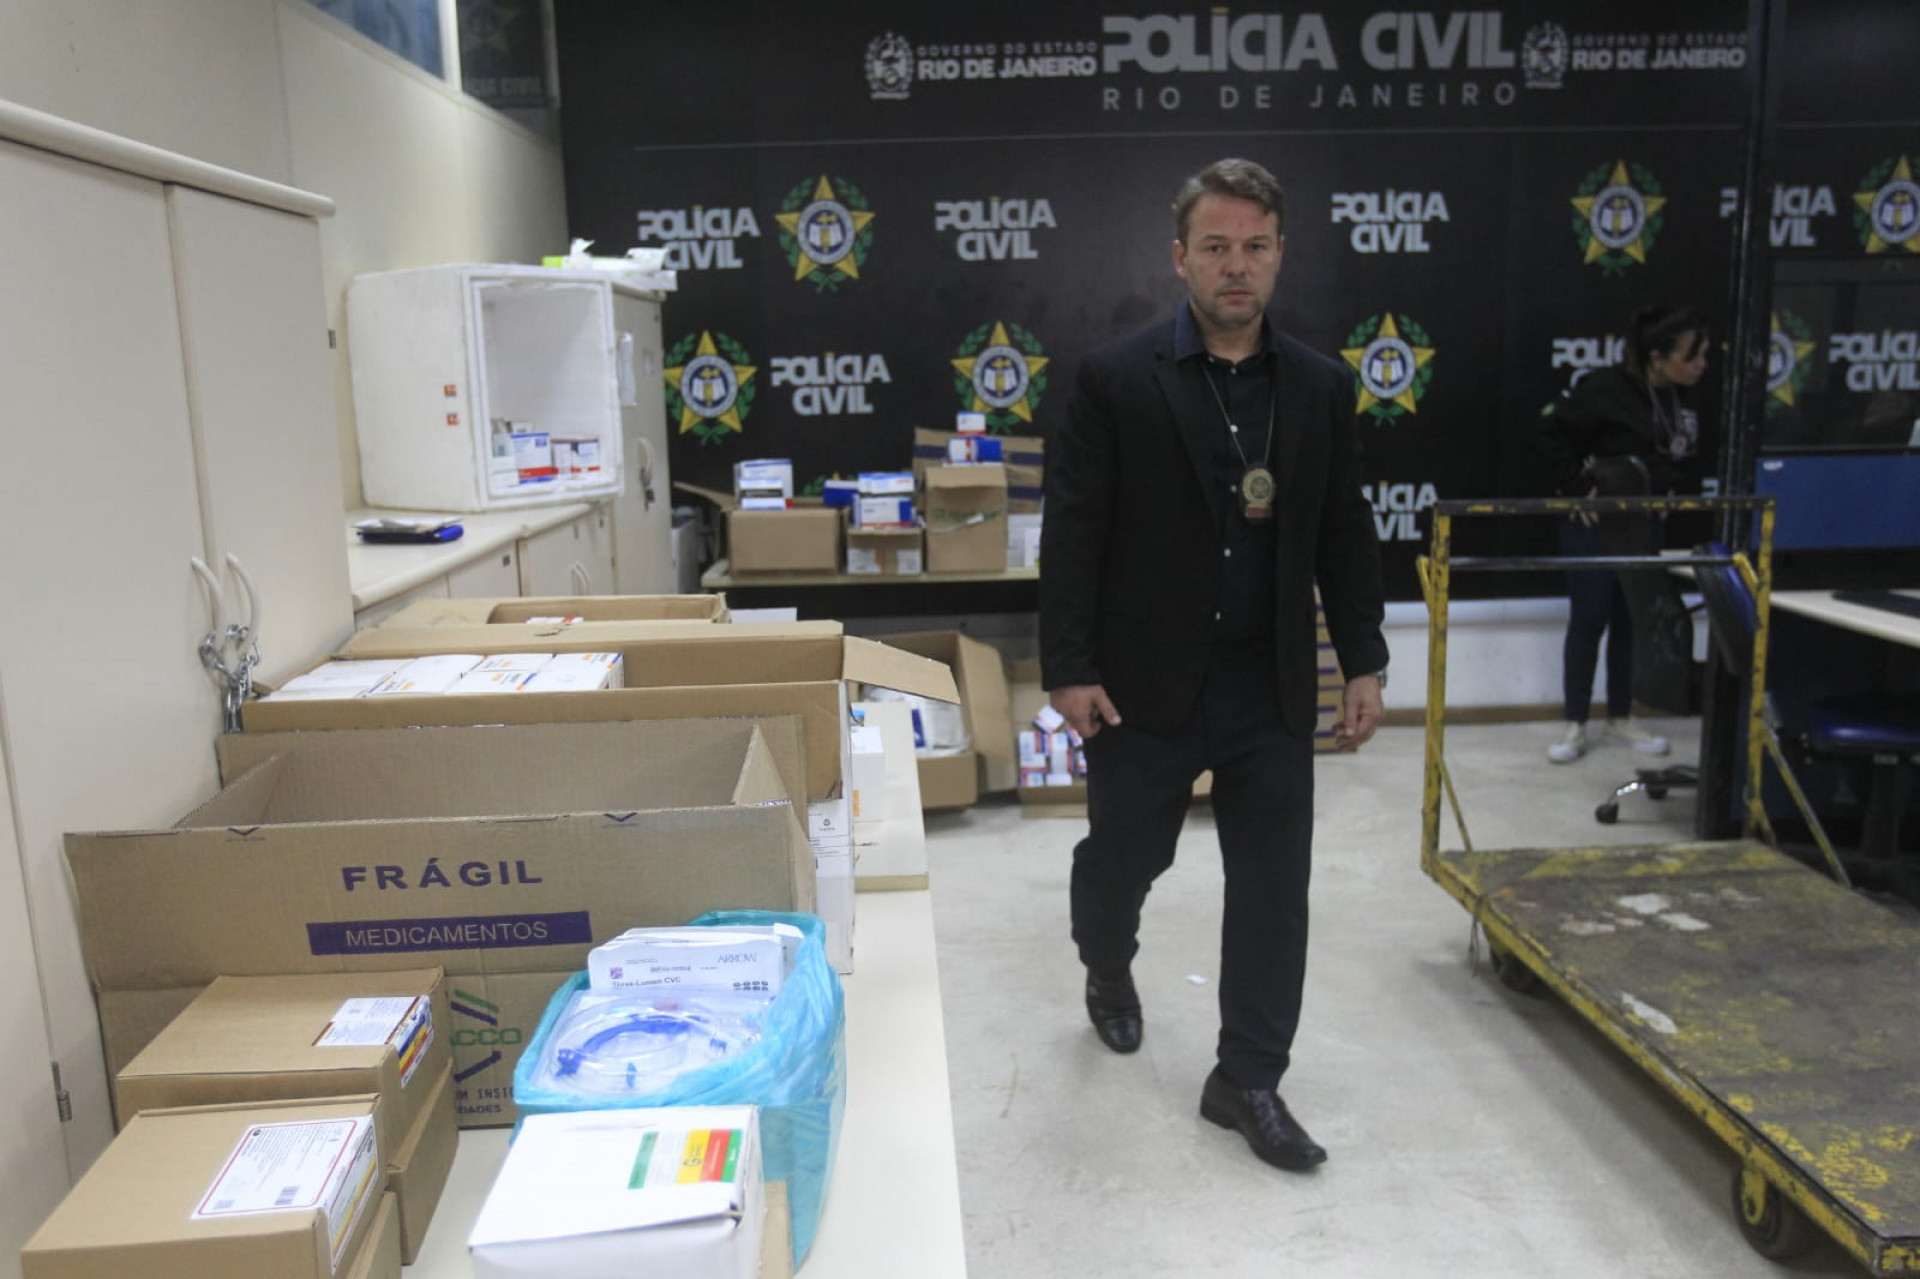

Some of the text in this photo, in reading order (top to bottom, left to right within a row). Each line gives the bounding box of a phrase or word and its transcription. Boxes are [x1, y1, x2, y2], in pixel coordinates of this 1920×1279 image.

[917, 41, 1097, 57] GOVERNO DO ESTADO
[1102, 7, 1516, 73] POLÍCIA CIVIL
[1572, 32, 1747, 47] GOVERNO DO ESTADO
[918, 56, 1097, 80] RIO DE JANEIRO
[1572, 48, 1746, 70] RIO DE JANEIRO
[1103, 82, 1516, 111] RIO DE JANEIRO
[935, 196, 1057, 231] POLÍCIA
[1331, 188, 1449, 223] POLÍCIA
[637, 205, 761, 240] POLÍCIA
[1769, 219, 1816, 246] VIL
[957, 230, 1038, 261] CIVIL
[1351, 223, 1430, 253] CIVIL
[662, 240, 744, 270] CIVIL
[1828, 331, 1920, 363] POLÍCI
[770, 351, 892, 386] POLÍCIA
[792, 385, 874, 415] CIVIL
[1373, 513, 1422, 541] VIL
[342, 857, 543, 891] FRÁGIL
[346, 921, 548, 947] MEDICAMENTOS
[450, 1028, 522, 1046] CCO
